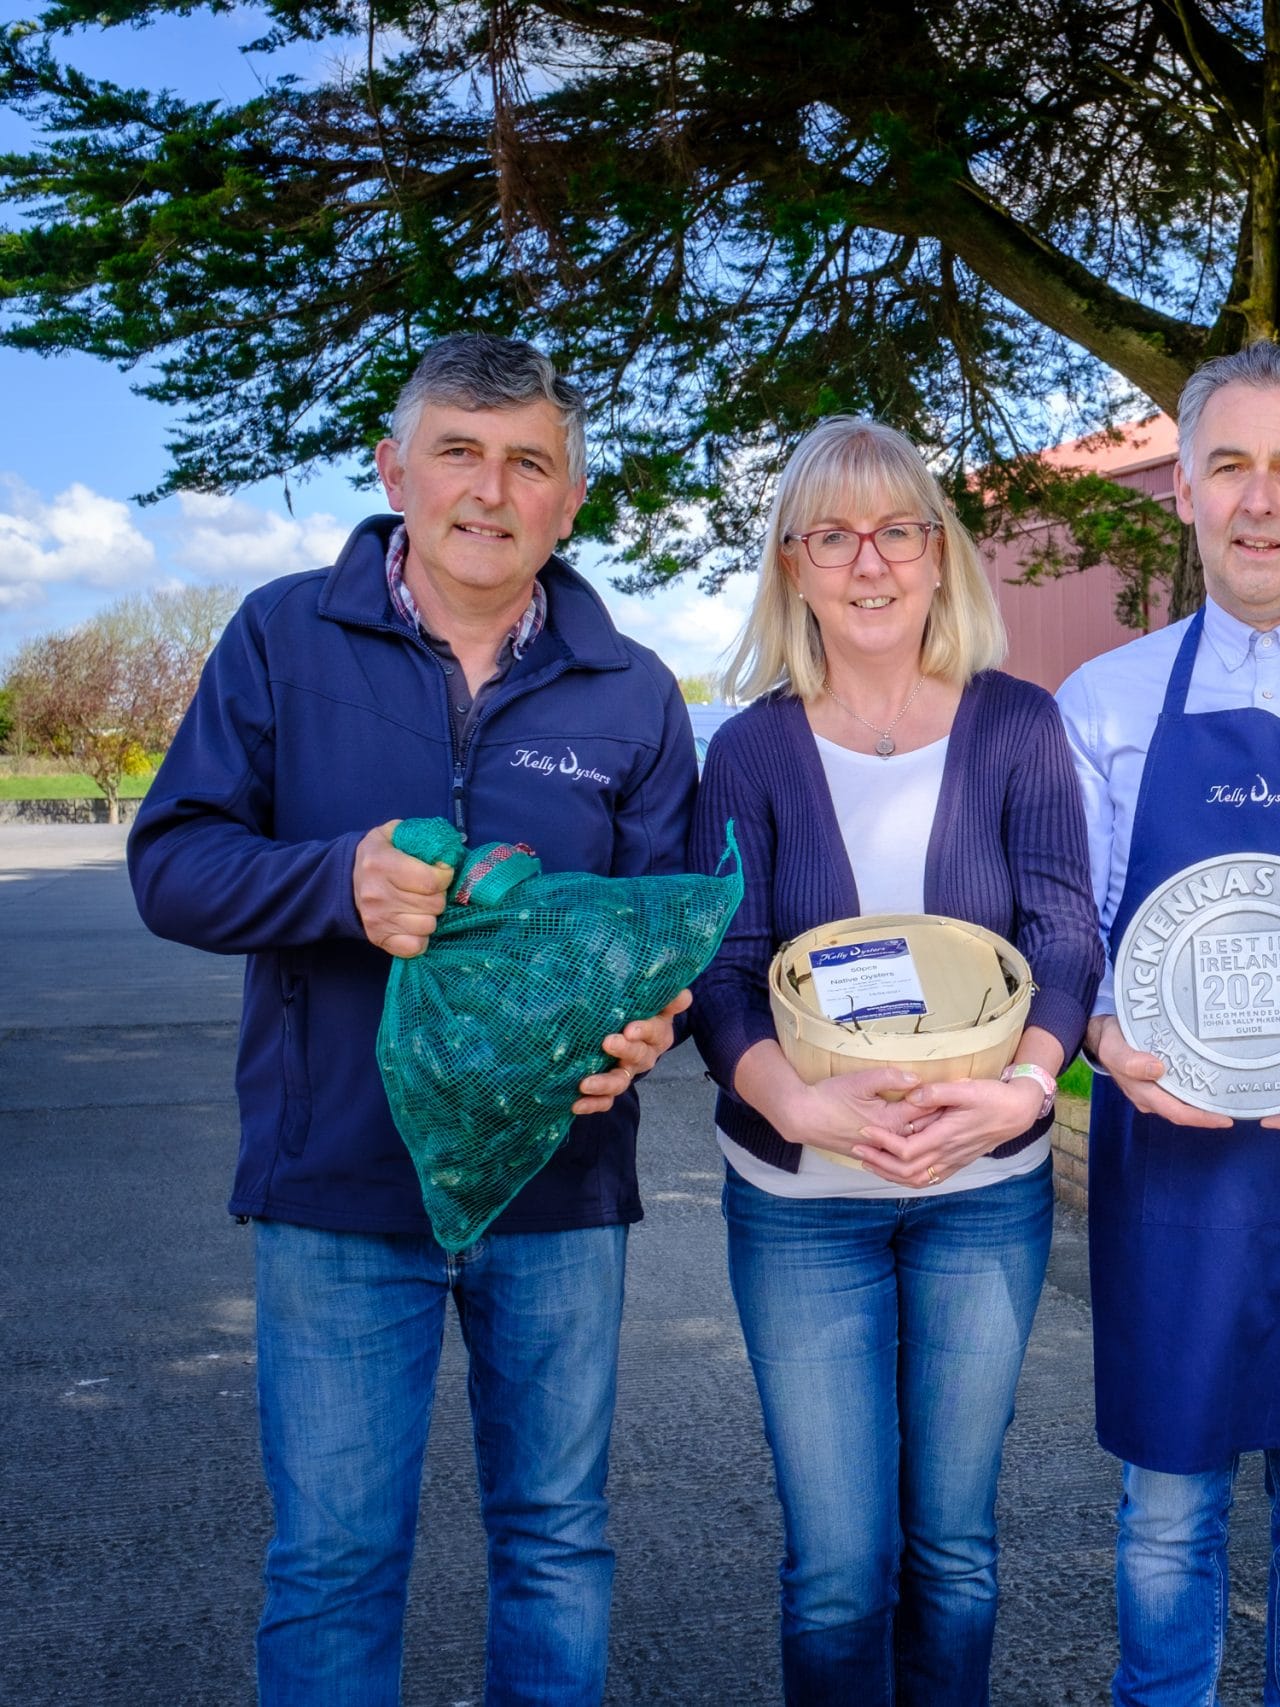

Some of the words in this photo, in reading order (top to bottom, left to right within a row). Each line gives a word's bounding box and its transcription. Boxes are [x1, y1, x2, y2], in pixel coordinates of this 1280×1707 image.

[510, 749, 557, 776] Kelly
[1206, 784, 1248, 808] Kelly
[1199, 936, 1260, 955] BEST
[819, 952, 848, 962] Kelly
[830, 976, 859, 985] Native
[860, 972, 895, 981] Oysters
[1203, 1009, 1280, 1020] RECOMMENDED
[1203, 1019, 1224, 1027] JOHN
[1235, 1026, 1263, 1034] GUIDE
